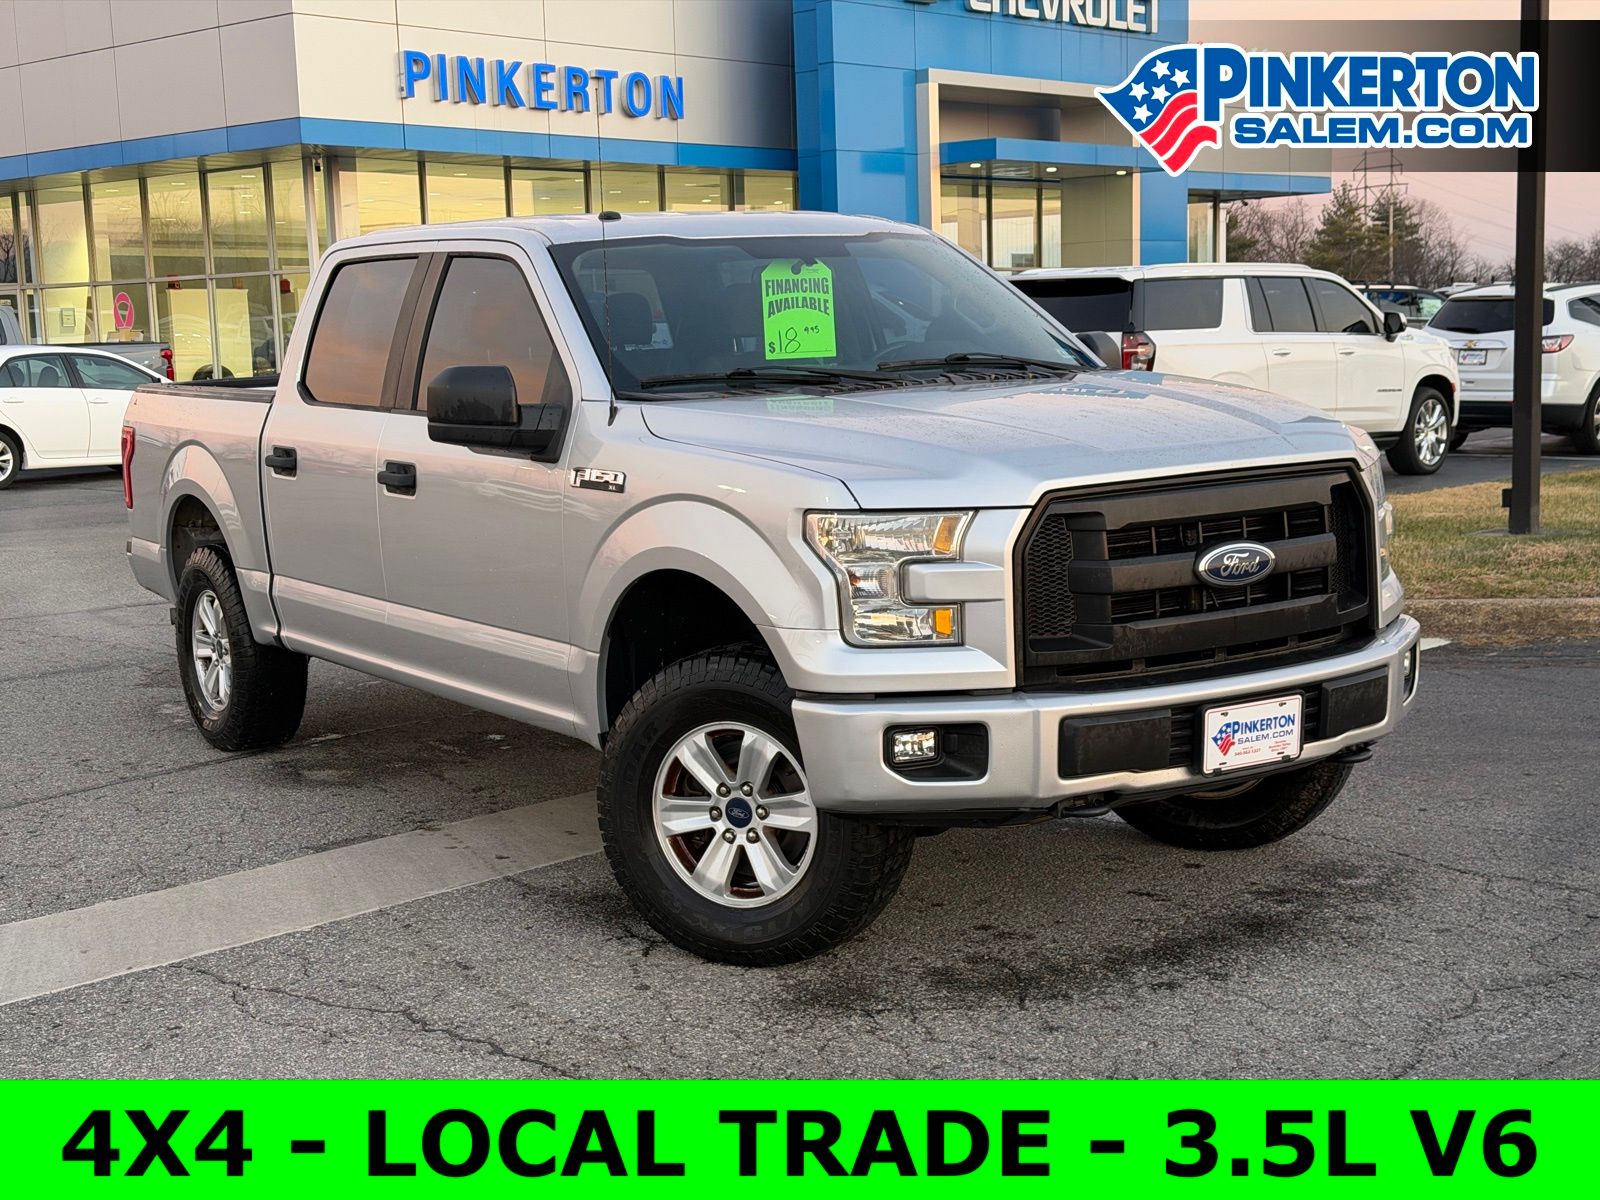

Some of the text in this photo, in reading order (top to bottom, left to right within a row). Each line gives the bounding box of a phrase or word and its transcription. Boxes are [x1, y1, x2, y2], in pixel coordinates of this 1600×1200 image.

[399, 50, 685, 120] PINKERTON
[765, 277, 829, 297] FINANCING
[768, 296, 829, 318] AVAILABLE
[1220, 552, 1260, 577] Ford
[1232, 714, 1296, 739] PINKERTON
[1237, 729, 1294, 745] SALEM.COM
